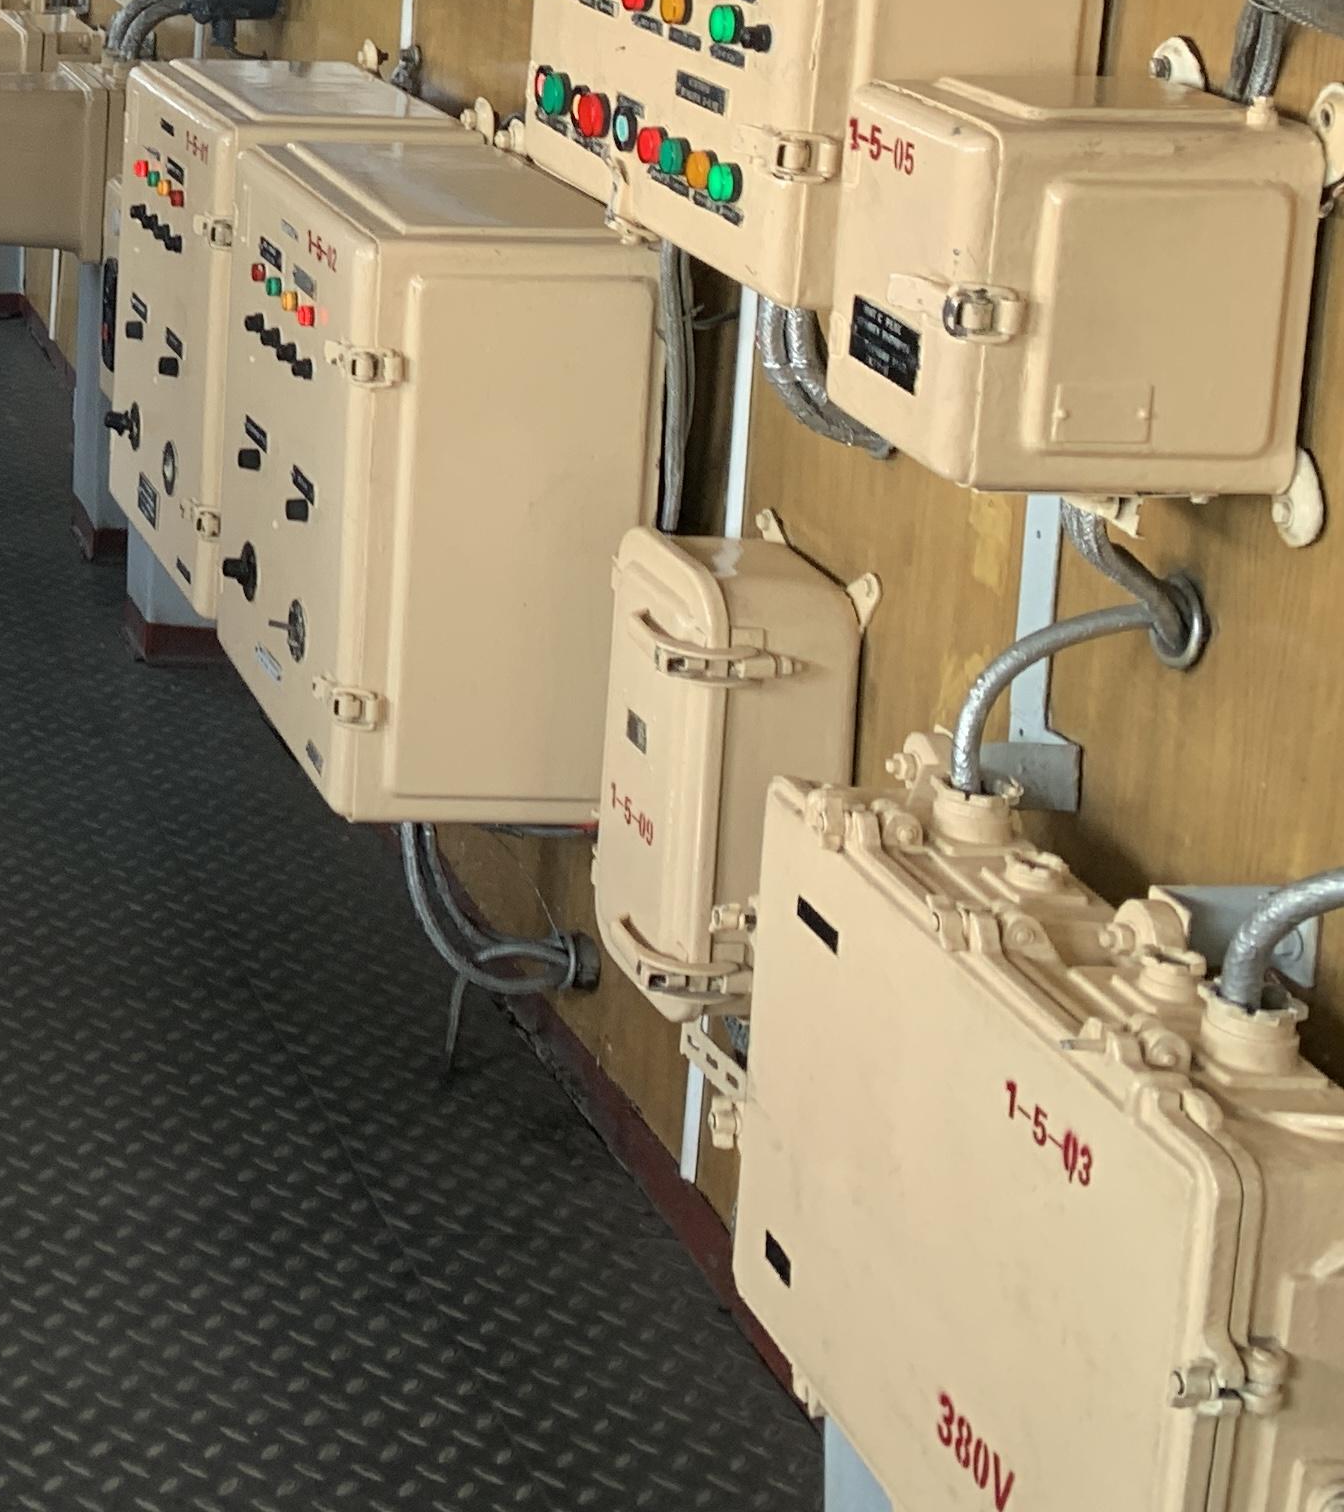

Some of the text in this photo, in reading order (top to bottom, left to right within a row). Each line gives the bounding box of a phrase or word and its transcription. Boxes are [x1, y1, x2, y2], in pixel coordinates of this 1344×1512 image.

[849, 116, 916, 176] 1-5-05
[1005, 1079, 1093, 1187] 1-5-03
[936, 1390, 1016, 1512] 380V
